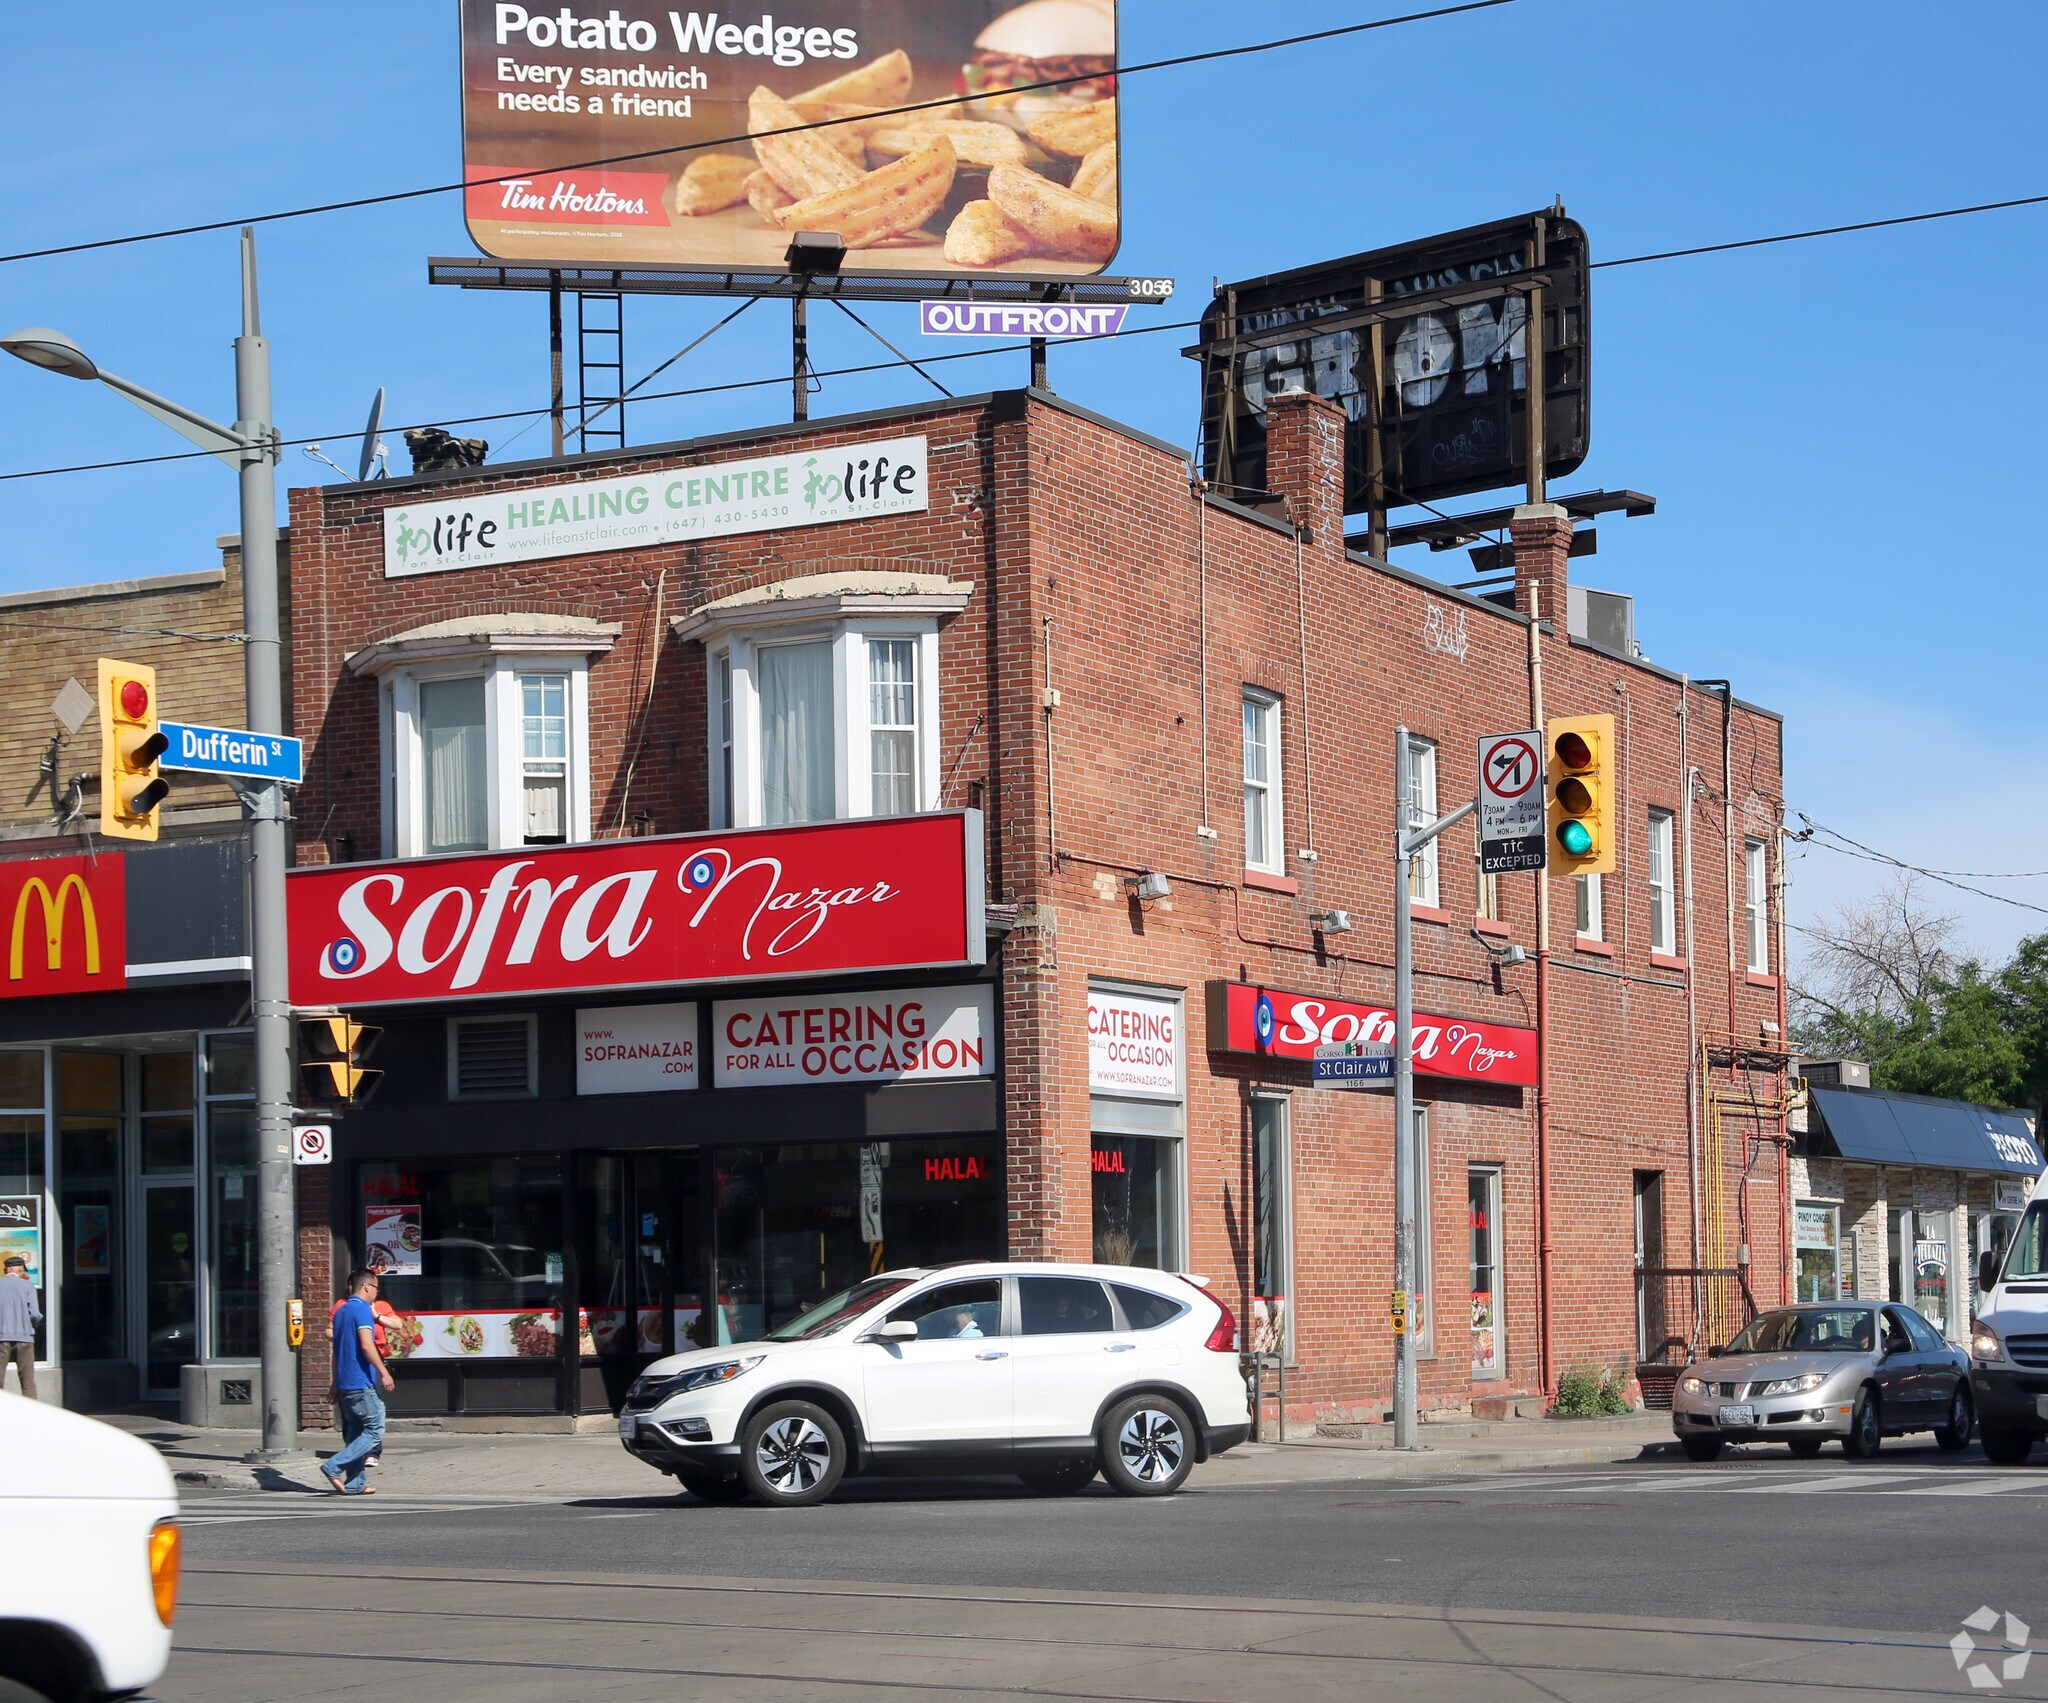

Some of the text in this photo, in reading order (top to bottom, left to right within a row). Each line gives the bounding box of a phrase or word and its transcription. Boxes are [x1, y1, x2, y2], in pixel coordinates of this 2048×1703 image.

[495, 3, 859, 67] Potato Wedges
[497, 57, 708, 90] Every sandwich
[497, 90, 692, 118] needs a friend
[499, 180, 546, 209] Tim
[928, 304, 1117, 334] OUTFRONT
[844, 456, 916, 503] life
[507, 466, 789, 530] HEALING CENTRE
[819, 508, 838, 516] on
[433, 512, 497, 555] life
[507, 505, 789, 550] www.lifeonstclair.com (647) 430-5430
[410, 561, 428, 569] on
[182, 729, 282, 767] Dufferin St
[1486, 814, 1538, 826] 4 PM 6 PM
[1485, 853, 1541, 869] EXCEPTED
[1502, 841, 1524, 854] TTC
[319, 847, 900, 989] Sofra Nazar
[726, 1002, 926, 1048] CATERING
[1088, 1006, 1173, 1043] CATERING
[584, 1041, 693, 1061] SOFRANAZAR
[726, 1037, 983, 1077] FOR ALL OCCASION
[1097, 1040, 1106, 1049] ALL
[1108, 1041, 1173, 1067] OCCASION
[1446, 1024, 1518, 1072] Nazar
[662, 1063, 694, 1075] .COM
[1097, 1070, 1173, 1087] WWW.SOFRANAZAR.COM
[1319, 1060, 1389, 1075] St Clair Av W
[1091, 1150, 1126, 1173] HALAL
[387, 1240, 400, 1249] OR
[1926, 1224, 1936, 1240] LA
